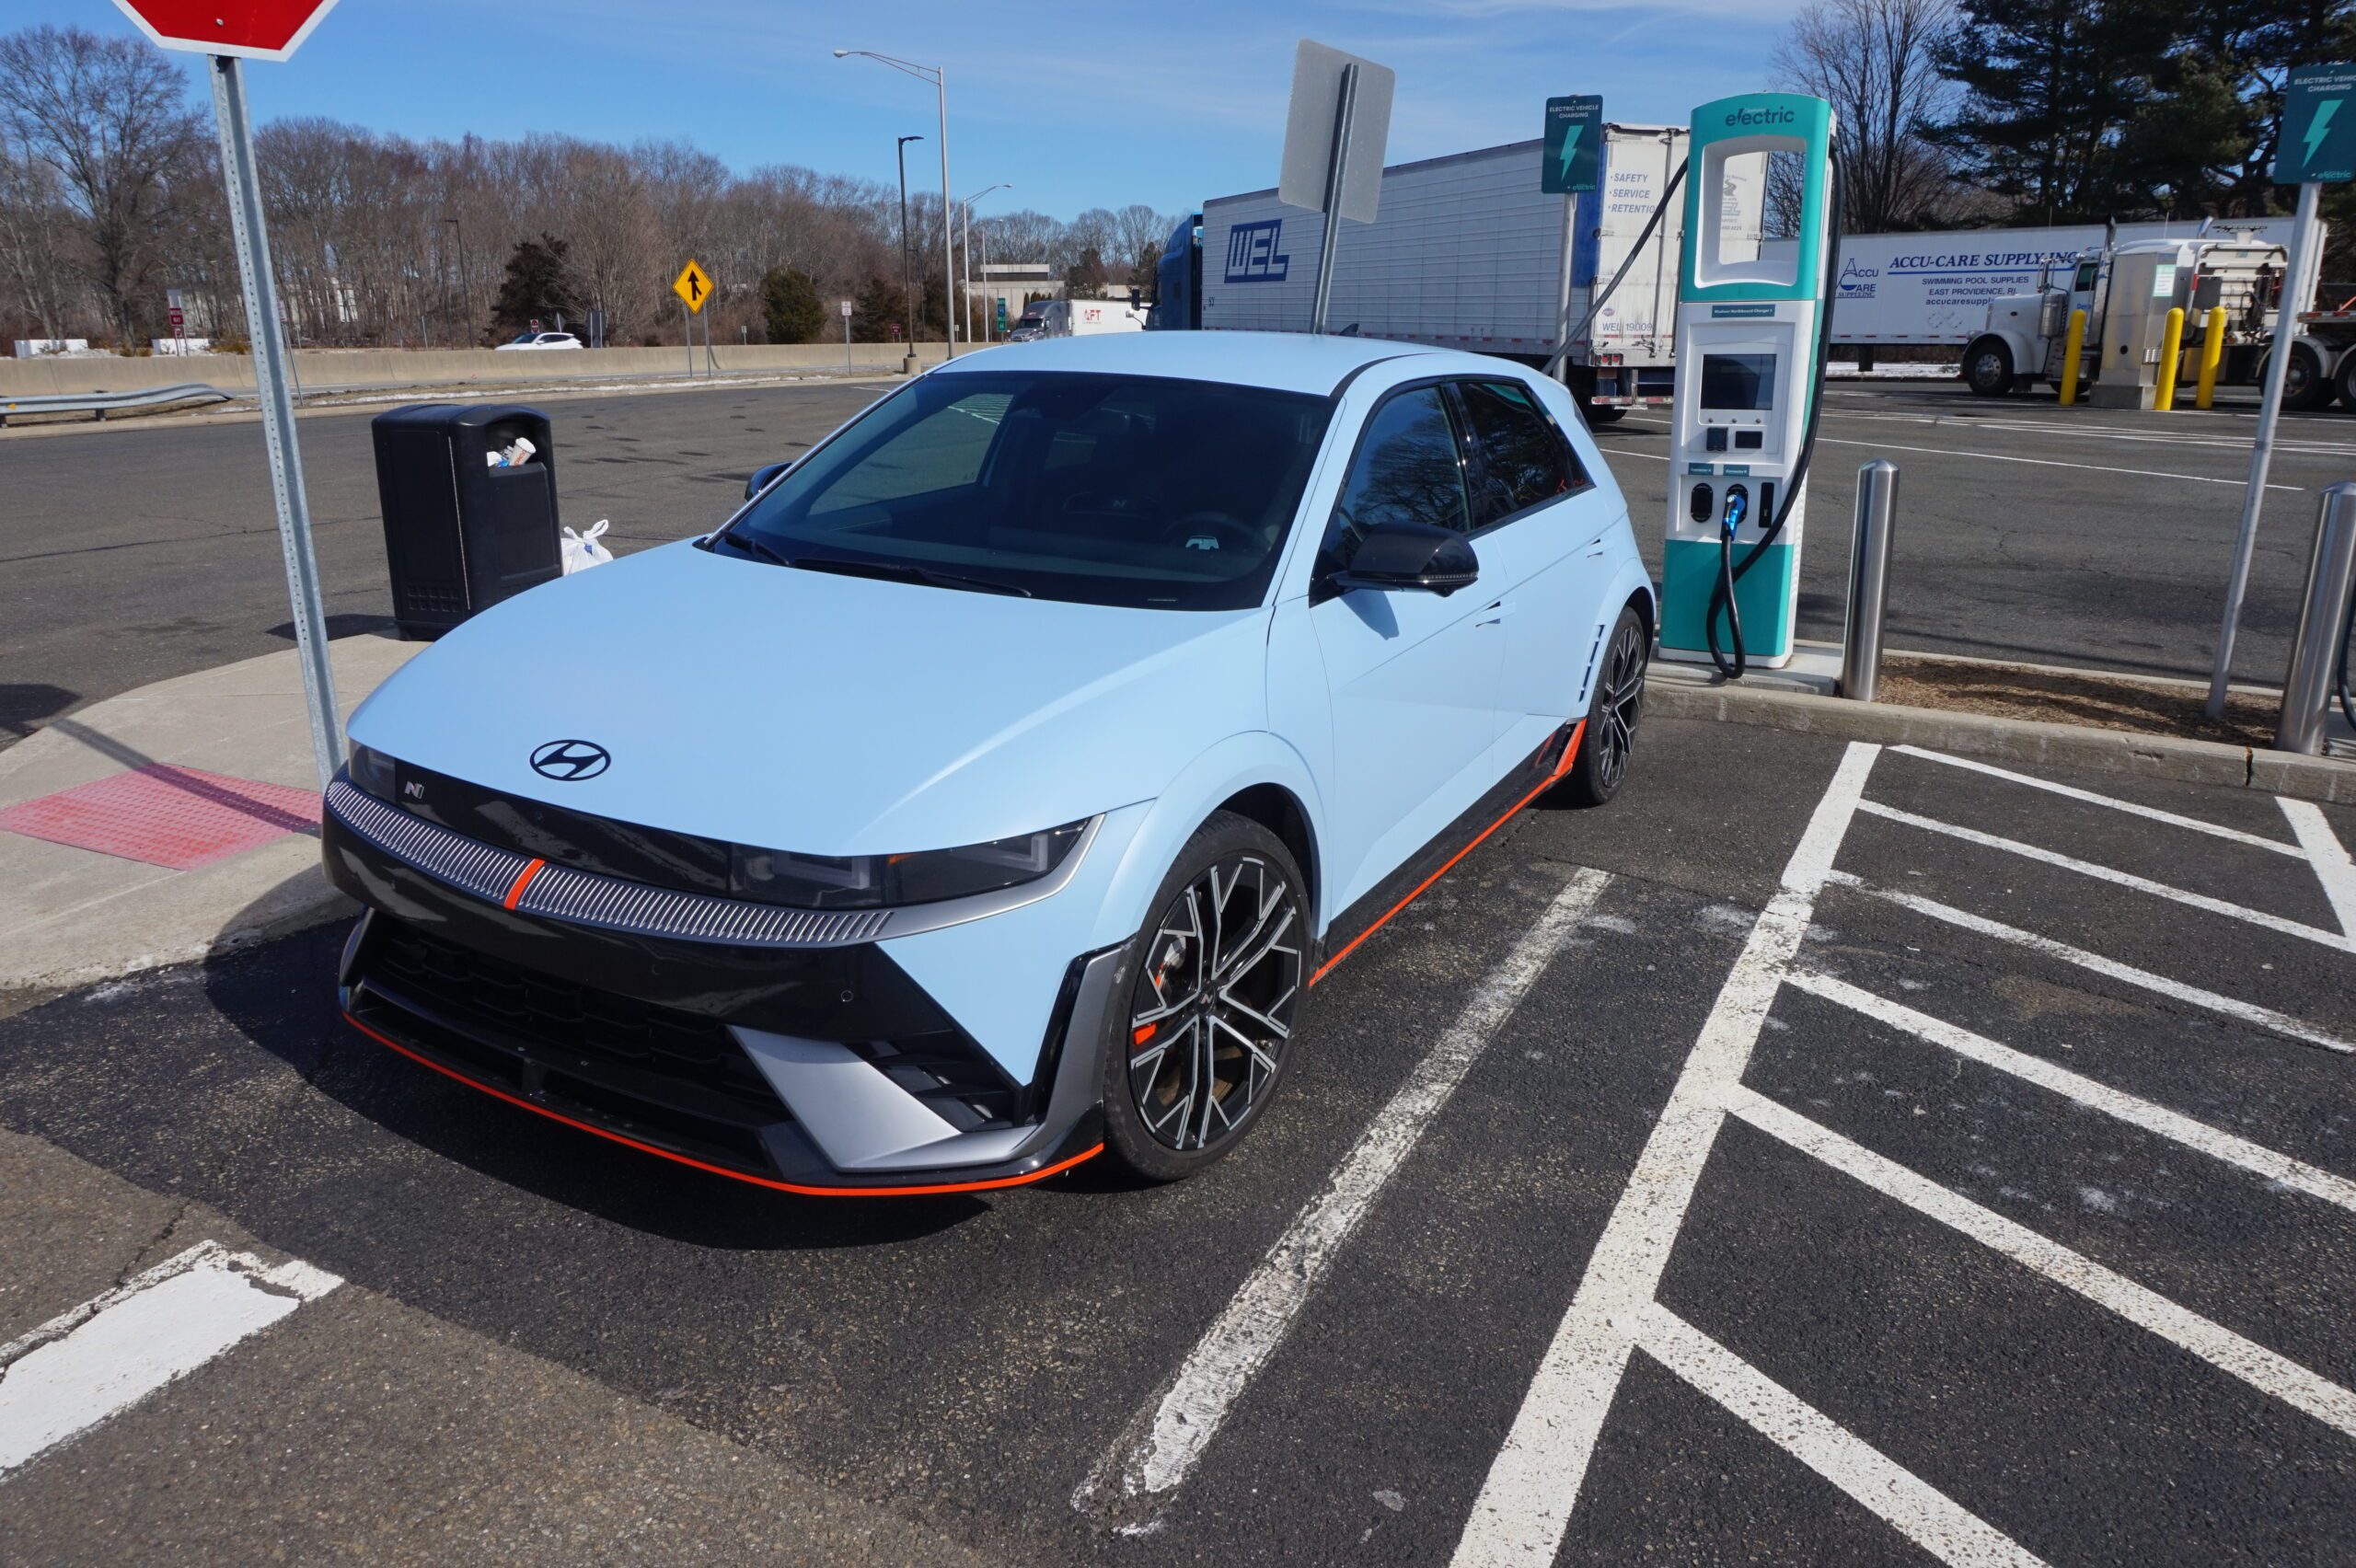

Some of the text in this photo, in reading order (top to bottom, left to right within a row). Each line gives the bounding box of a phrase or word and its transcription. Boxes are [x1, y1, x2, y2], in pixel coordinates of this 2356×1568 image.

[2293, 75, 2332, 85] ELECTRIC
[2307, 84, 2352, 92] CHARGING
[1725, 106, 1795, 126] electric
[1613, 173, 1648, 183] SAFETY
[1612, 189, 1650, 199] SERVICE
[1611, 203, 1657, 214] RETENTIO
[1224, 218, 1290, 283] WEL
[1888, 254, 1981, 269] ACCU-CARE
[1922, 277, 1962, 285] SWIMMING
[1951, 287, 2005, 295] PROVIDENCE,
[1602, 322, 1621, 331] WEL
